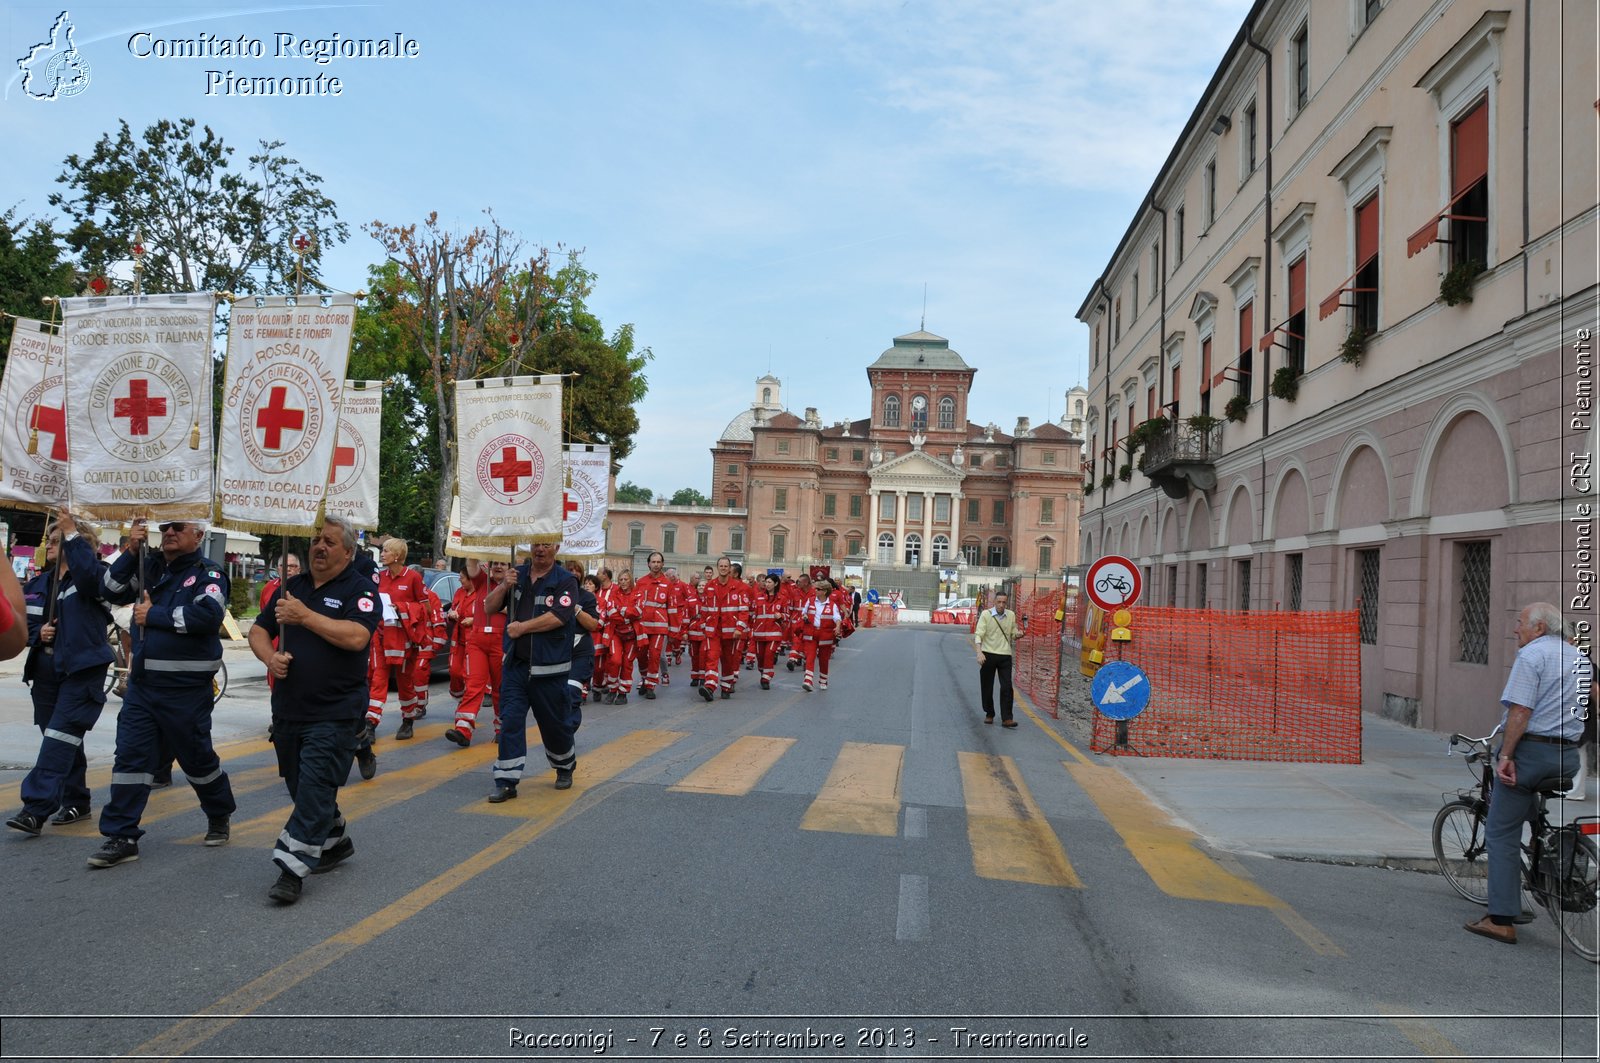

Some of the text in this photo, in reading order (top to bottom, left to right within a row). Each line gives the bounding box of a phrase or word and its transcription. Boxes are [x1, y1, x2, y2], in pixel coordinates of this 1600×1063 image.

[78, 314, 198, 329] CORPO VOLONTARI DEL SOCCORSO
[298, 314, 311, 325] DEL
[72, 330, 204, 346] CROCE ROSSA ITALIANA
[296, 328, 303, 339] E
[21, 338, 46, 351] CORPO
[12, 347, 55, 366] CROCE
[92, 356, 191, 409] CONVENZIONE DI GINEVRA
[228, 343, 340, 412] CROCE ROSSA ITALIANA
[254, 376, 266, 389] DI
[268, 366, 309, 388] GINEVRA
[303, 406, 319, 450] AGOSTO
[468, 408, 552, 440] CROCE ROSSA ITALIANA
[281, 450, 305, 468] 1864
[489, 443, 498, 451] DI
[497, 435, 525, 446] GINEVRA
[525, 443, 535, 452] 22
[532, 451, 543, 481] AGOSTO
[84, 469, 200, 484] COMITATO LOCALE DI
[112, 487, 176, 500] MONESIGLIO
[223, 479, 324, 496] COMITATO LOCALE DI
[576, 469, 605, 504] ITALIANA
[264, 496, 321, 512] DALMAZZ
[489, 515, 536, 526] CENTALLO
[564, 540, 599, 548] MOROZZO
